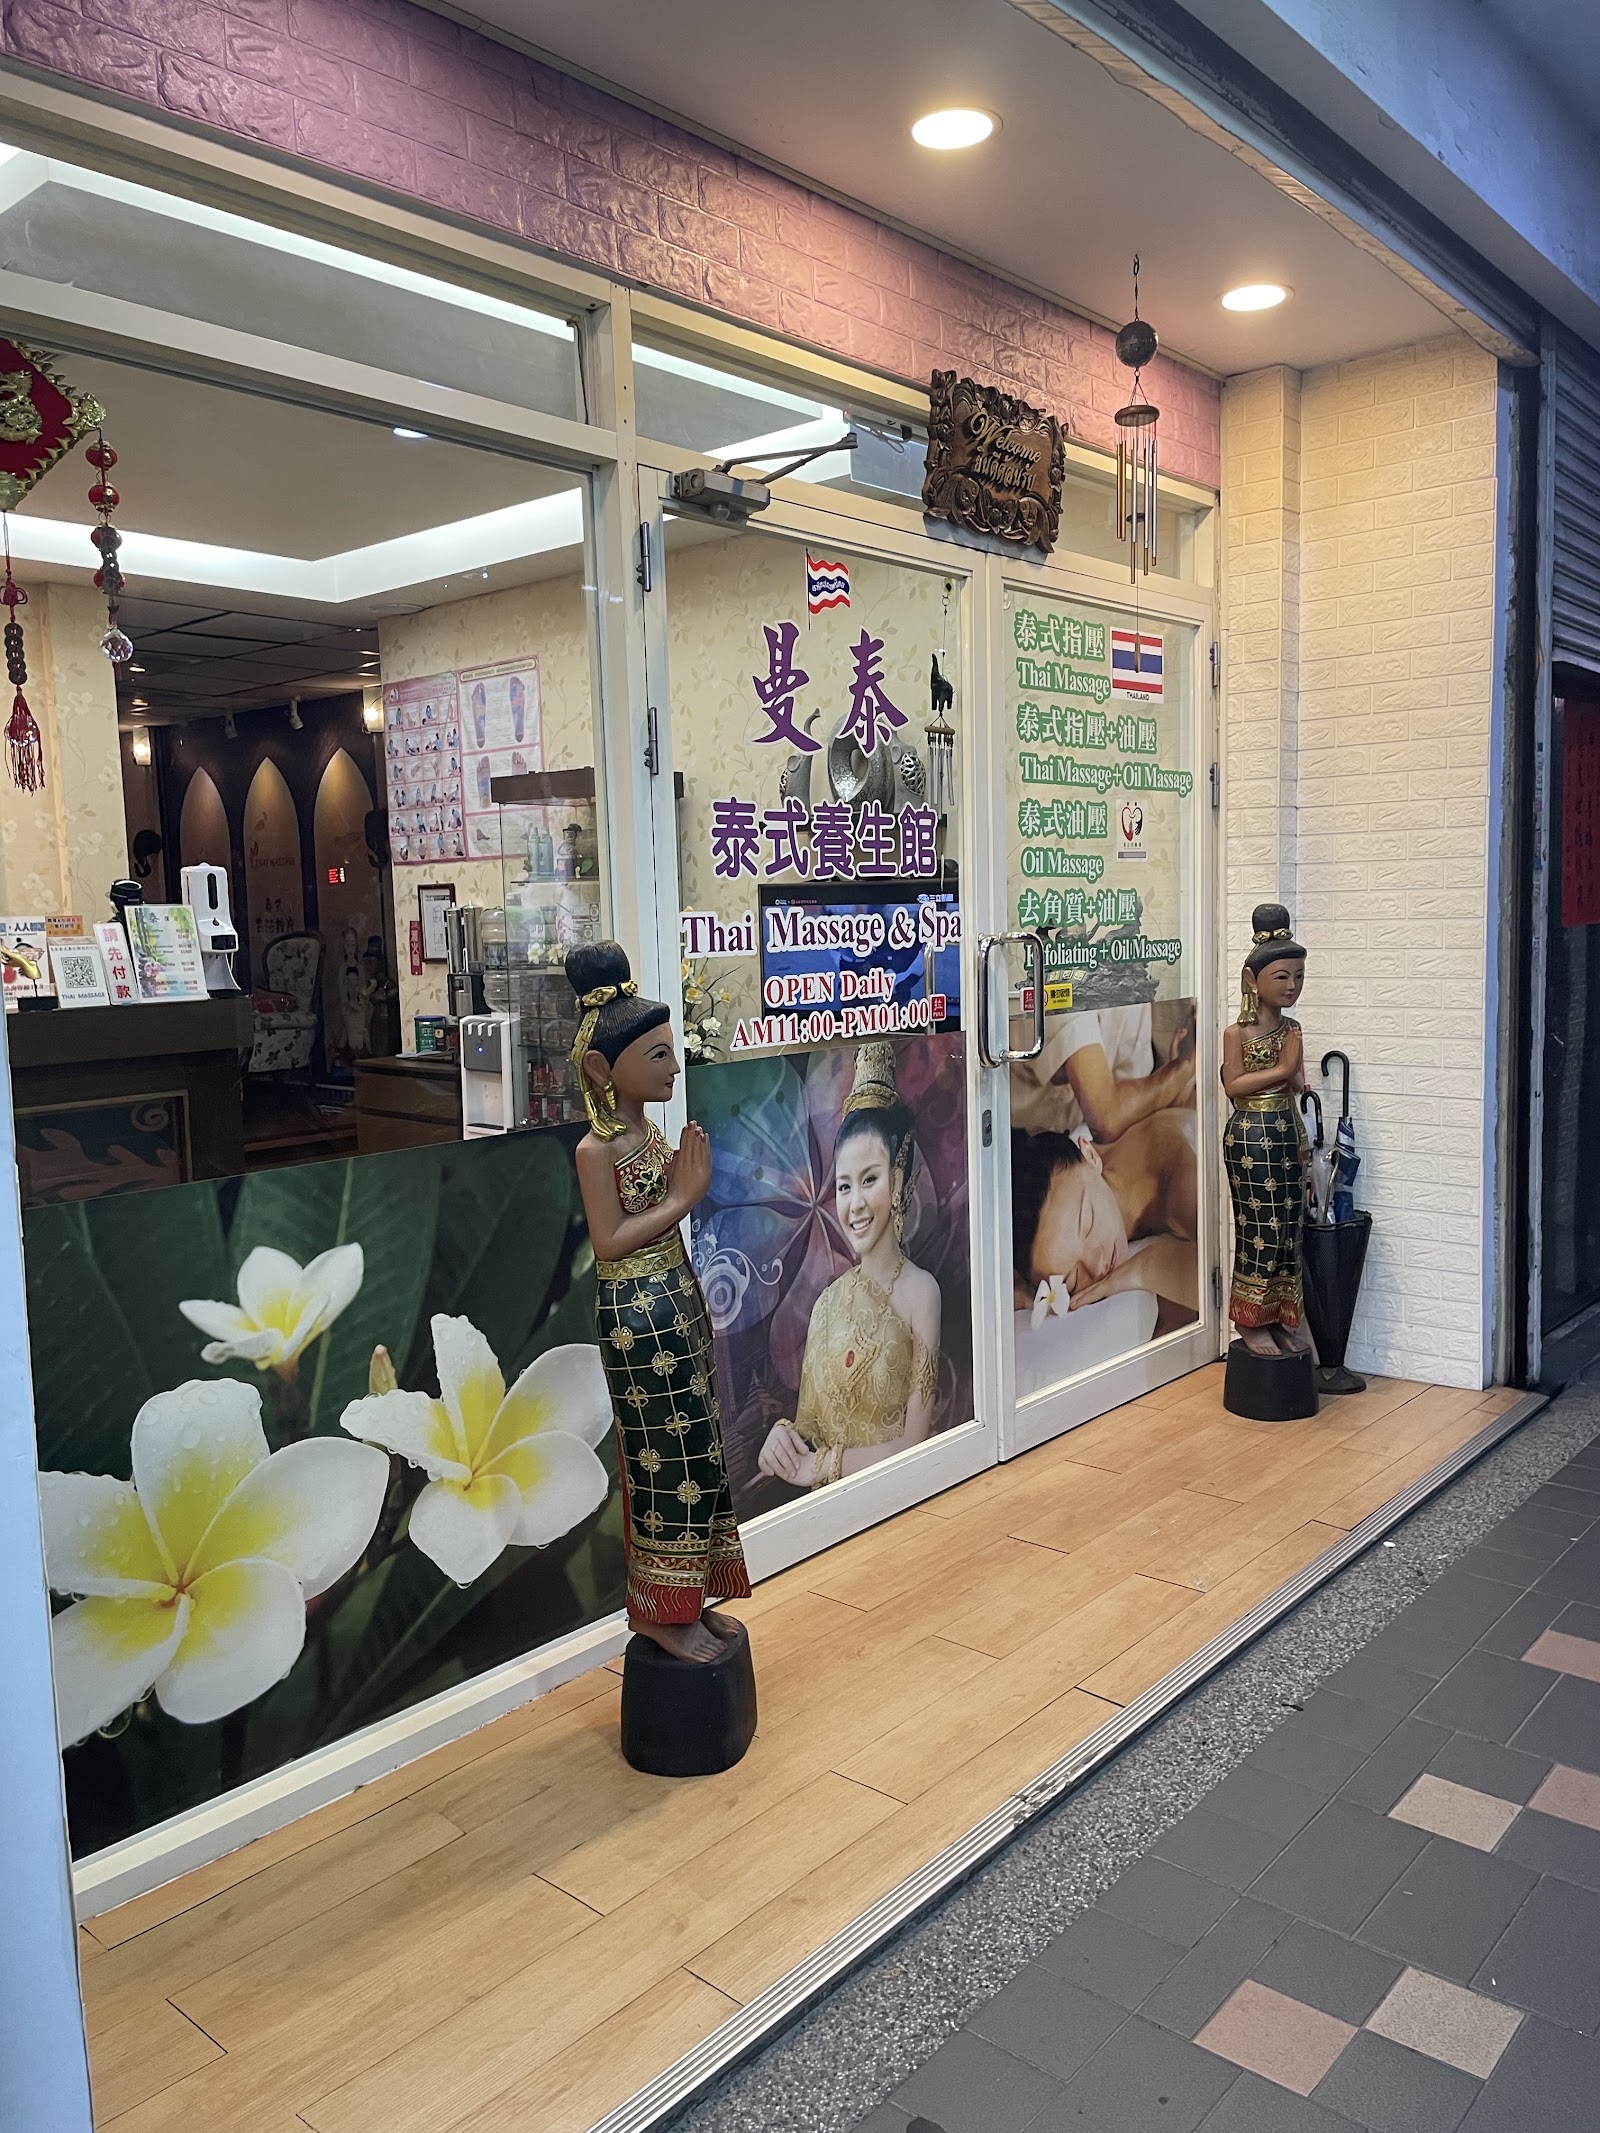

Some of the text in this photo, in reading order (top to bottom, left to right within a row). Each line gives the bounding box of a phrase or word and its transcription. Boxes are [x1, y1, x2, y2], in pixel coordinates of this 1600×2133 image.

[971, 411, 1041, 463] Welcome
[1016, 613, 1104, 659] 泰式指壓
[752, 622, 909, 754] 曼泰
[1018, 661, 1110, 700] Thai Massage
[1126, 692, 1149, 701] THAILAND
[1019, 706, 1156, 751] 泰式指壓+油壓
[1022, 756, 1053, 781] Thai
[1145, 766, 1192, 794] Massage
[712, 797, 937, 878] 泰式養生館
[1020, 802, 1106, 836] 泰式油壓
[1023, 851, 1103, 880] Oil Massage
[1020, 891, 1136, 924] 去角質+油壓
[682, 906, 962, 953] Thai Massage & Spa
[1026, 941, 1097, 968] Efoliating
[1111, 939, 1130, 961] Oil
[1132, 937, 1181, 965] Massage
[766, 969, 894, 1005] OPEN Daily
[934, 998, 943, 1011] 拉
[733, 1001, 929, 1048] AM11:00-PM01:00
